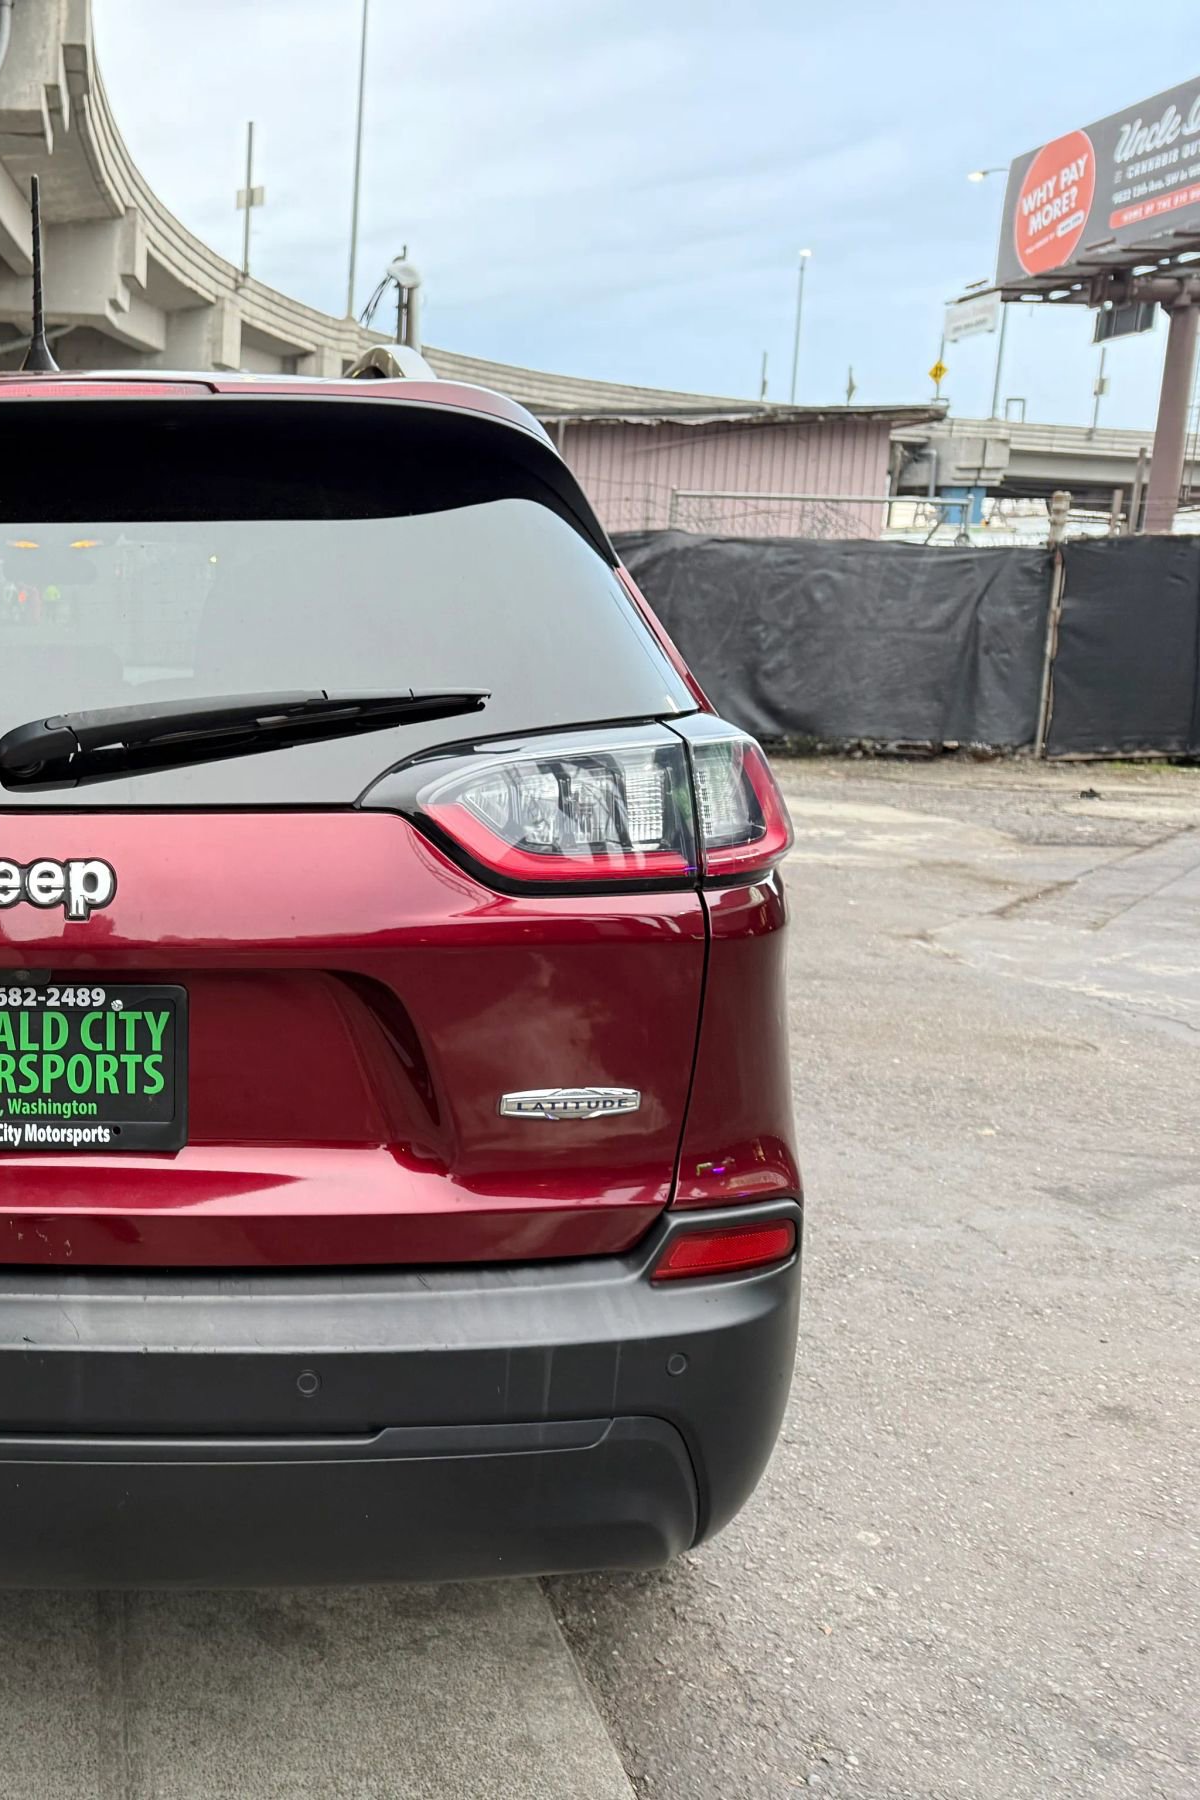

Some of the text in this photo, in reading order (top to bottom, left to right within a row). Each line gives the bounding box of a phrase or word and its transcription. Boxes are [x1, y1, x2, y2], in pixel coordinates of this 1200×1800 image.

[1114, 104, 1181, 163] Uncle
[1023, 153, 1089, 216] WHY PAY
[1028, 186, 1079, 236] MORE?
[80, 1011, 170, 1051] CITY
[7, 1098, 97, 1119] Washington
[516, 1098, 629, 1111] LATITUDE
[24, 1124, 111, 1146] Motorsports
